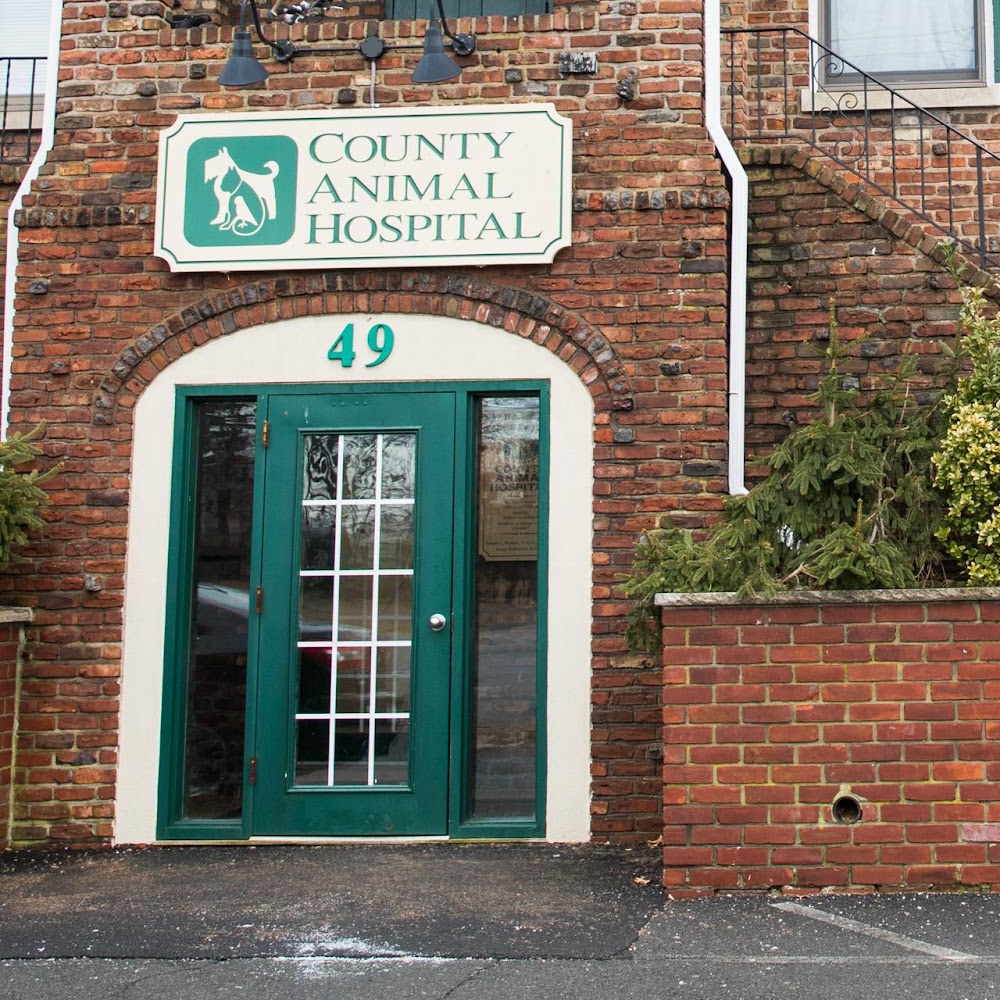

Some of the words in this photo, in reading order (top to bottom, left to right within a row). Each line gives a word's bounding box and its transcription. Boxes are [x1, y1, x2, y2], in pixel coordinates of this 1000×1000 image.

[308, 131, 516, 165] COUNTY
[306, 171, 514, 204] ANIMAL
[304, 211, 544, 245] HOSPITAL
[327, 322, 395, 368] 49
